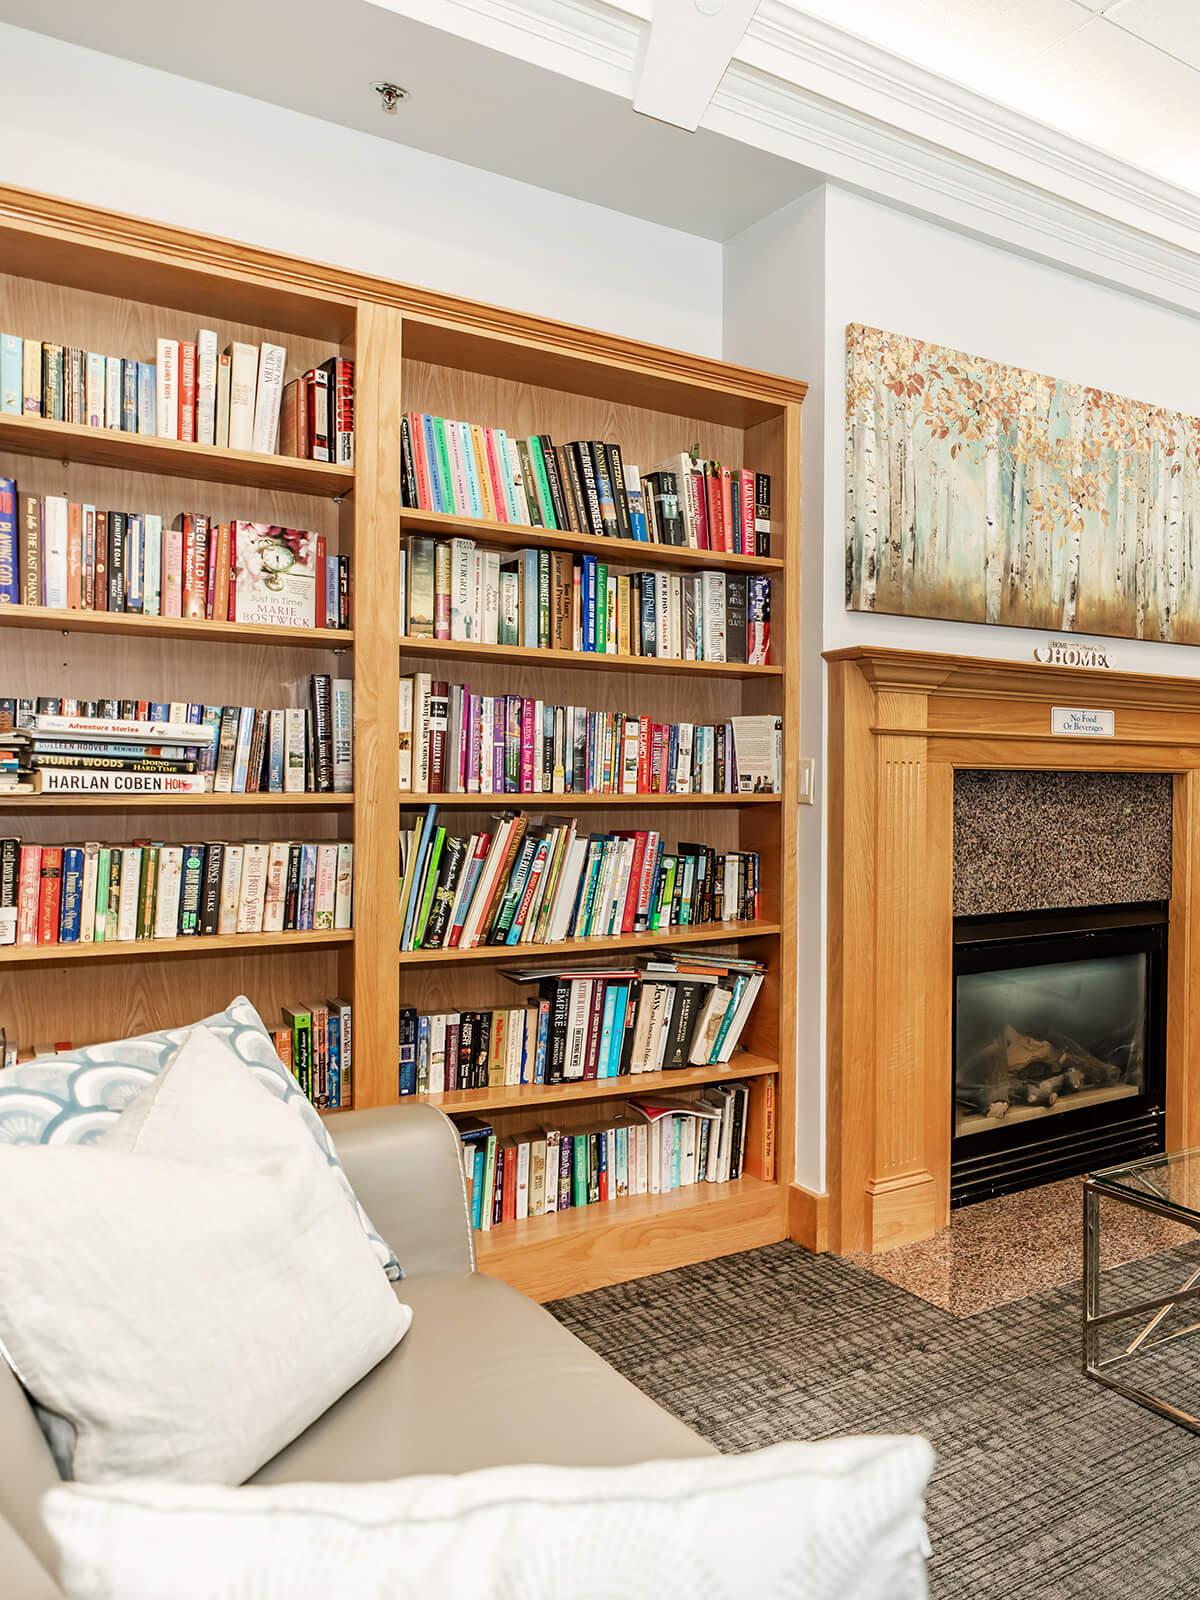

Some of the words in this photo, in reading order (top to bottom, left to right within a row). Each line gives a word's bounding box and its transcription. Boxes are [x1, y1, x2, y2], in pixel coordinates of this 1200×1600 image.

[164, 346, 172, 360] THE
[184, 345, 195, 357] TESS
[164, 361, 172, 381] GLORY
[183, 358, 194, 386] GERRITSEN
[263, 350, 274, 383] SOLUTION
[164, 384, 172, 400] BOYS
[182, 405, 193, 442] BLOODSTREAM
[582, 456, 593, 478] RIVER
[596, 444, 607, 472] FANNIE
[612, 450, 623, 489] CHUTZPAH
[551, 483, 559, 497] Heart
[586, 480, 594, 488] OF
[744, 482, 754, 508] ALWAYS
[588, 490, 600, 529] DARKNESS
[0, 522, 12, 563] PLAYING
[27, 532, 37, 548] THE
[187, 532, 195, 547] The
[745, 520, 754, 553] FOREVER
[196, 519, 206, 577] REGINALD
[28, 551, 37, 569] LAST
[185, 548, 194, 591] Woodcutter
[0, 565, 12, 586] GOD
[459, 552, 467, 605] EVERGREEN
[243, 612, 310, 628] BOSTWICK
[256, 604, 297, 616] MARIE
[422, 691, 431, 716] Modern
[68, 722, 110, 732] Adventure
[111, 724, 140, 733] Stories
[640, 718, 648, 732] TOM
[1064, 722, 1072, 730] Or
[1074, 724, 1104, 732] Beverages
[1070, 714, 1080, 722] No
[1082, 714, 1096, 723] Food
[77, 742, 108, 752] HOOVER
[639, 733, 647, 759] CLANCY
[653, 731, 662, 746] JANET
[319, 740, 332, 758] Point
[336, 741, 350, 764] FALL
[38, 755, 79, 766] STUART
[83, 756, 124, 768] WOODS
[133, 764, 156, 772] HARD
[157, 765, 177, 773] TIME
[142, 758, 170, 766] DOING
[652, 747, 661, 775] EVANOVICH
[49, 775, 109, 790] HARLAN
[114, 776, 162, 790] COBEN
[517, 817, 526, 835] TINY
[507, 836, 522, 862] HOMES
[649, 833, 657, 847] THE
[522, 841, 535, 861] JAMES
[646, 848, 655, 867] FIRST
[3, 862, 14, 882] DAVID
[186, 869, 199, 883] DAN
[511, 861, 530, 894] PATTERSON
[184, 885, 197, 911] BROWN
[640, 868, 654, 908] IMMORTAL
[207, 890, 215, 912] SILKS
[517, 889, 534, 924] COOKBOOK
[498, 902, 515, 930] BLINDSIDE
[576, 981, 587, 1004] ARTHUR
[652, 985, 666, 1010] Jews
[554, 988, 566, 1027] EMPIRE
[575, 1005, 585, 1026] HAILEY
[573, 1036, 582, 1054] EVENING
[645, 1022, 655, 1048] American
[572, 1054, 580, 1067] NEWS
